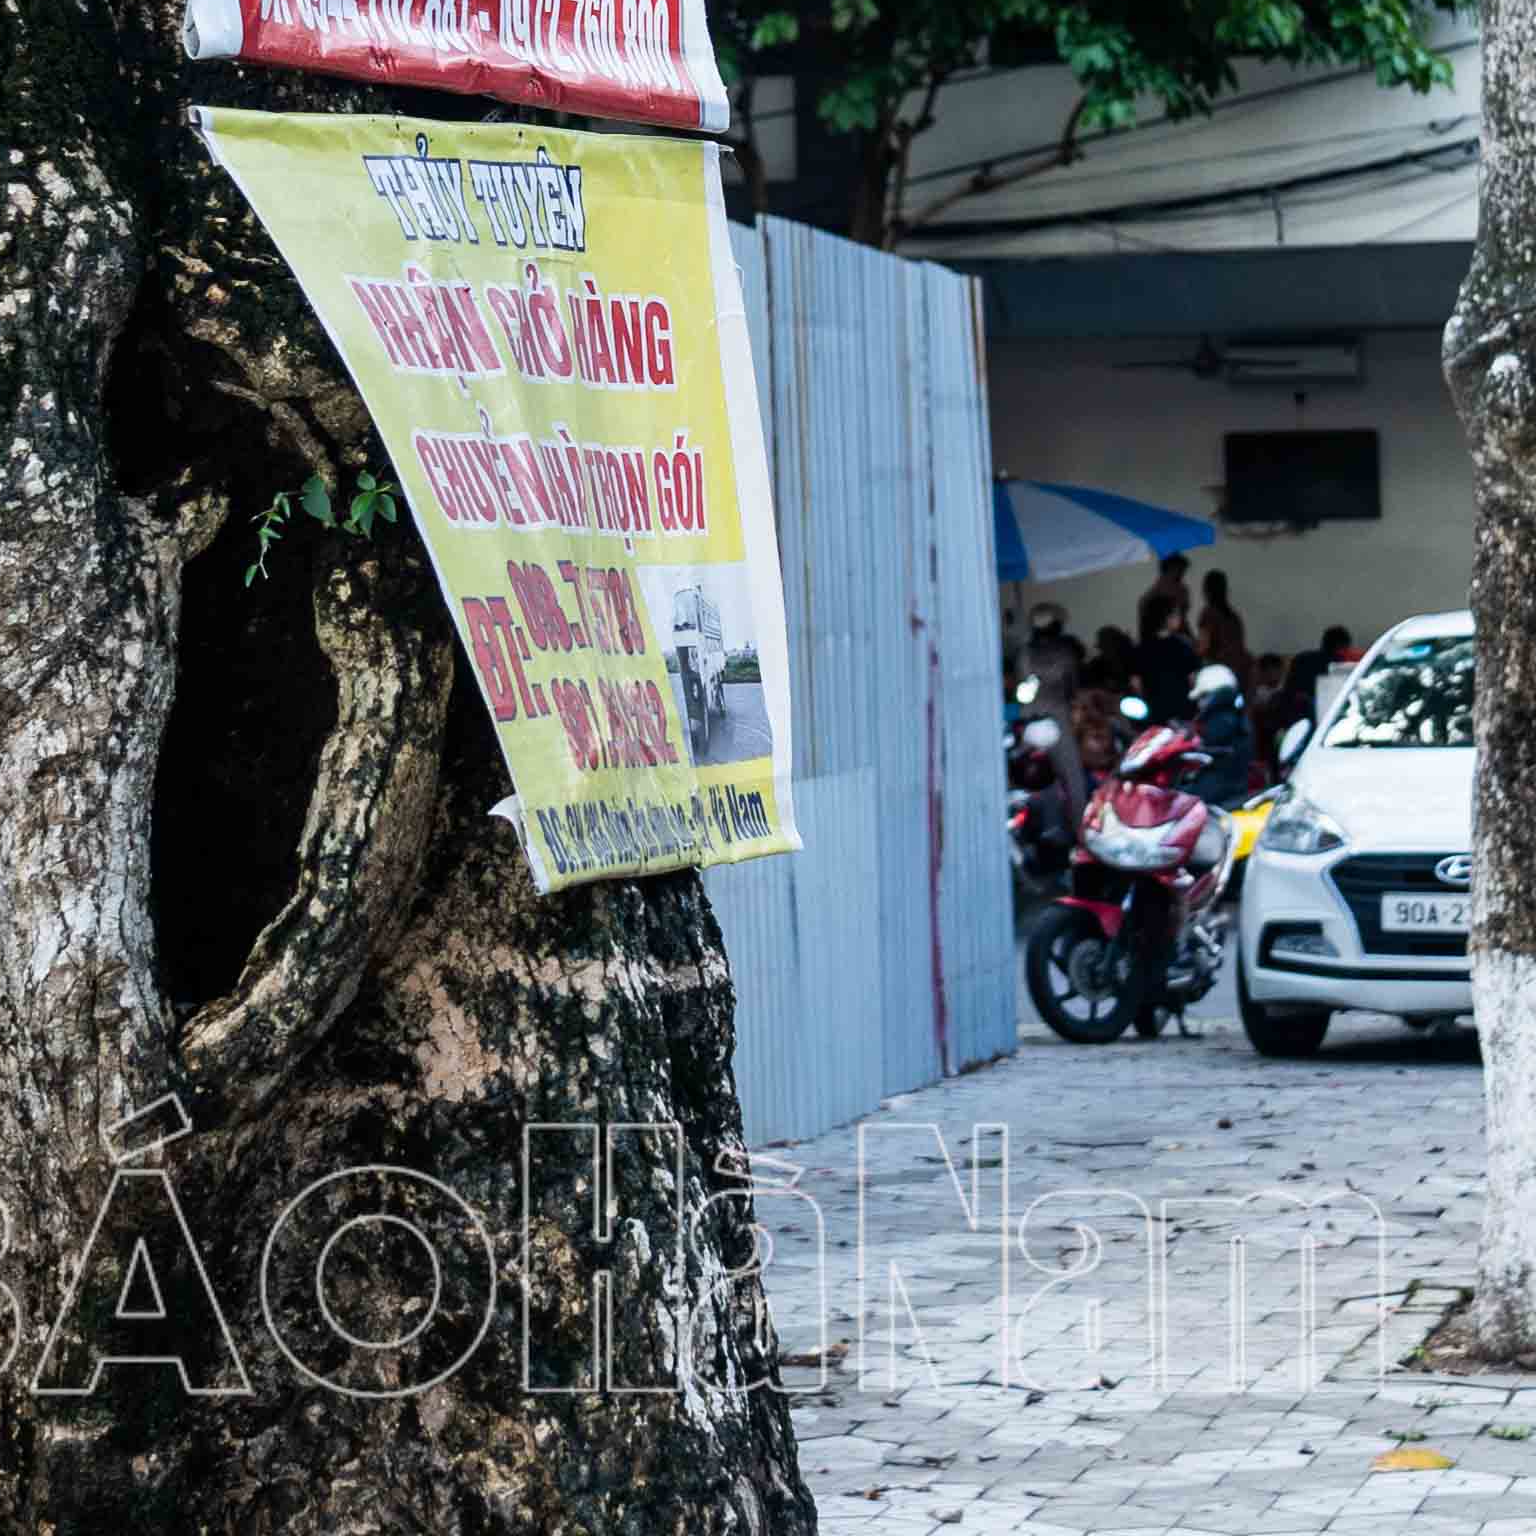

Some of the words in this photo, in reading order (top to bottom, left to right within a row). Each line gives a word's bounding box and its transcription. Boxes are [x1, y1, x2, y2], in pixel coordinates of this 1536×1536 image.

[350, 266, 502, 390] NHẬN
[568, 279, 674, 385] HÀNG
[583, 448, 652, 551] TRỌN
[653, 435, 706, 531] GÓI
[725, 783, 773, 841] Nam
[1396, 901, 1471, 924] 90A-2
